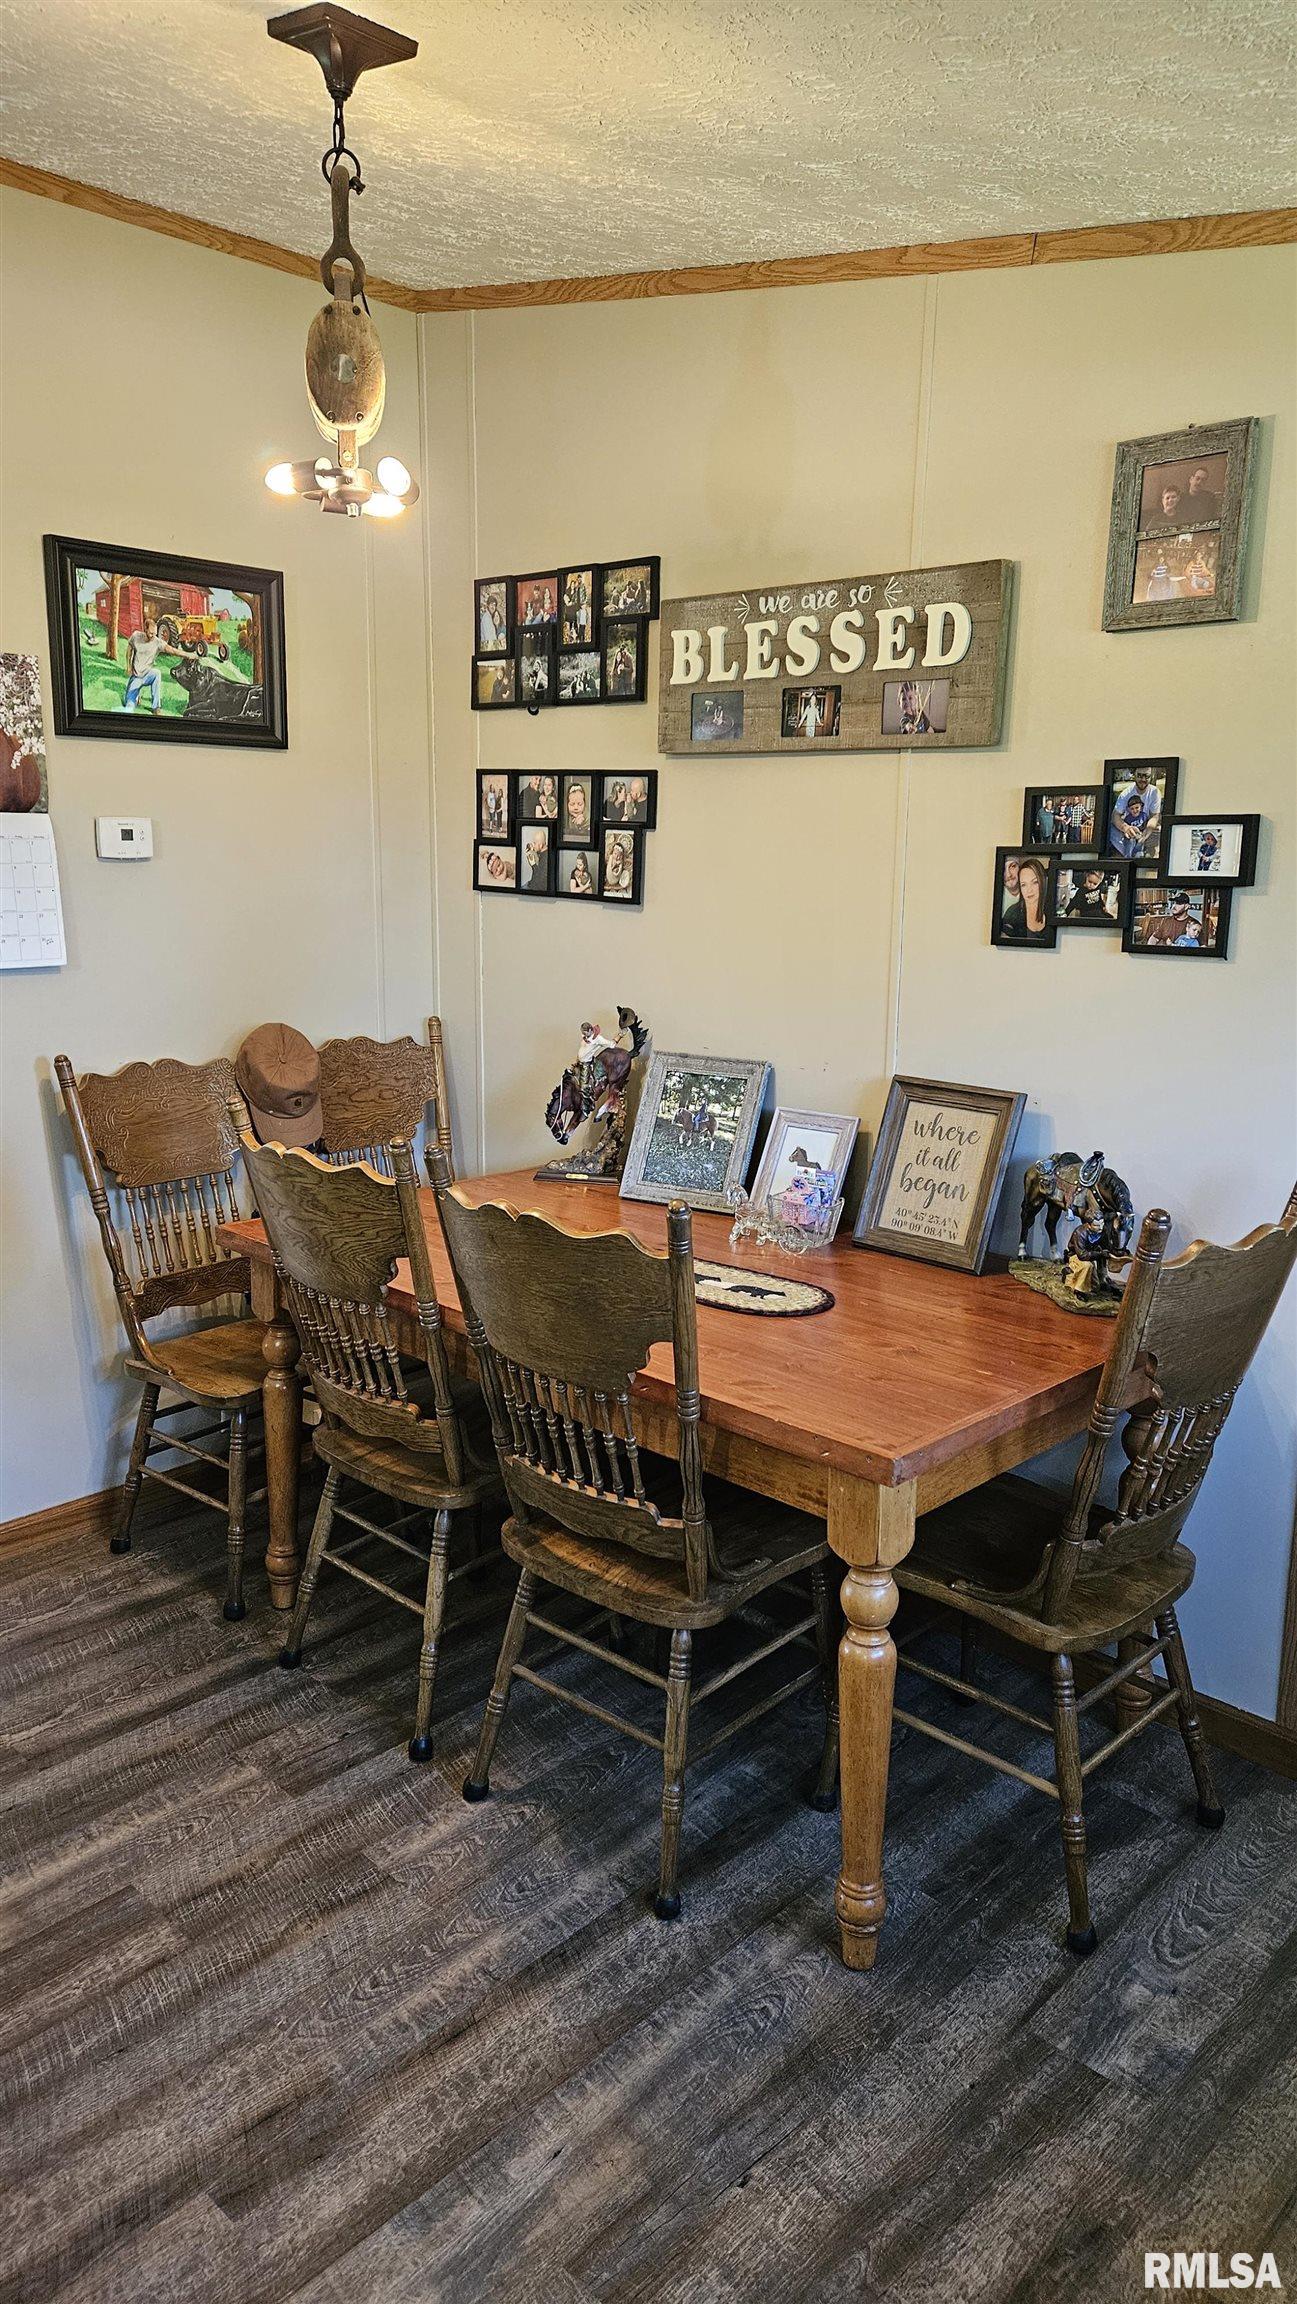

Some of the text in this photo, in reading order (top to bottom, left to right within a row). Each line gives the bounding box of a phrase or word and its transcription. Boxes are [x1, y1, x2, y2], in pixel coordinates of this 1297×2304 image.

[759, 584, 876, 614] we are so
[670, 602, 973, 685] BLESSED
[914, 1112, 981, 1146] where
[916, 1147, 961, 1172] it all
[900, 1163, 969, 1209] began
